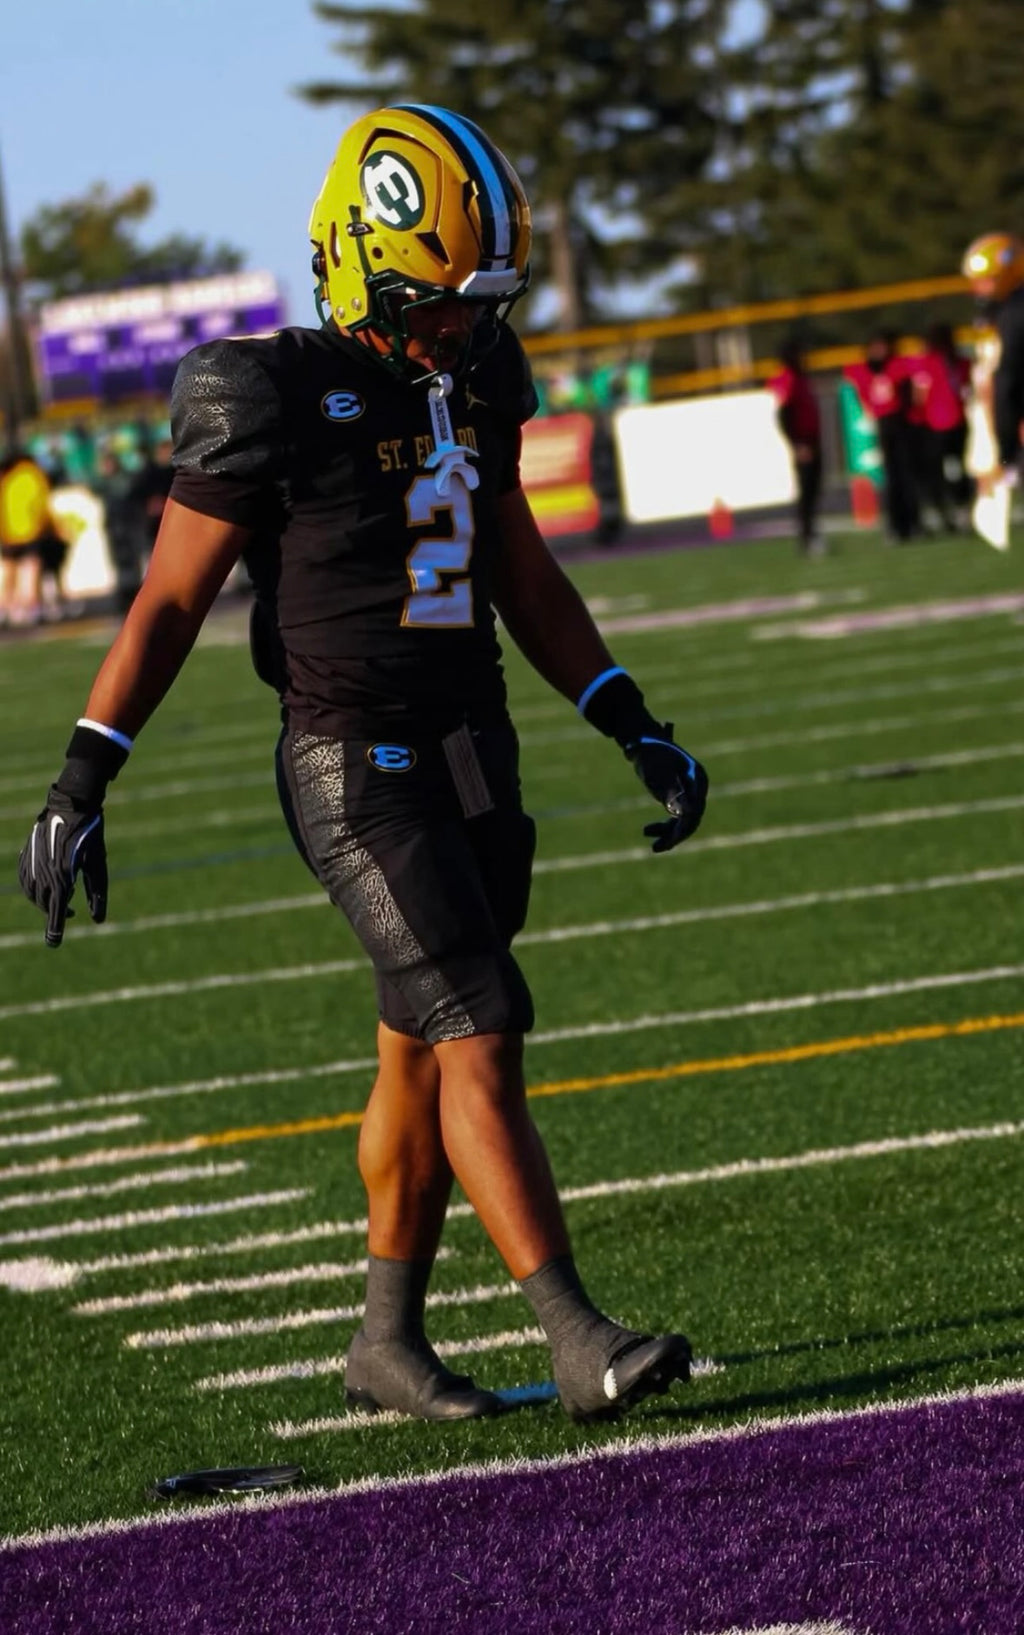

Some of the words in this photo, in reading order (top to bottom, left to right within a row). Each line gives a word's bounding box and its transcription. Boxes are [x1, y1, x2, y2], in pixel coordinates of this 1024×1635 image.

[364, 154, 420, 225] E
[325, 393, 361, 418] E
[377, 439, 408, 472] ST.
[414, 426, 478, 467] EDRD
[400, 474, 476, 628] 2
[372, 745, 410, 768] E
